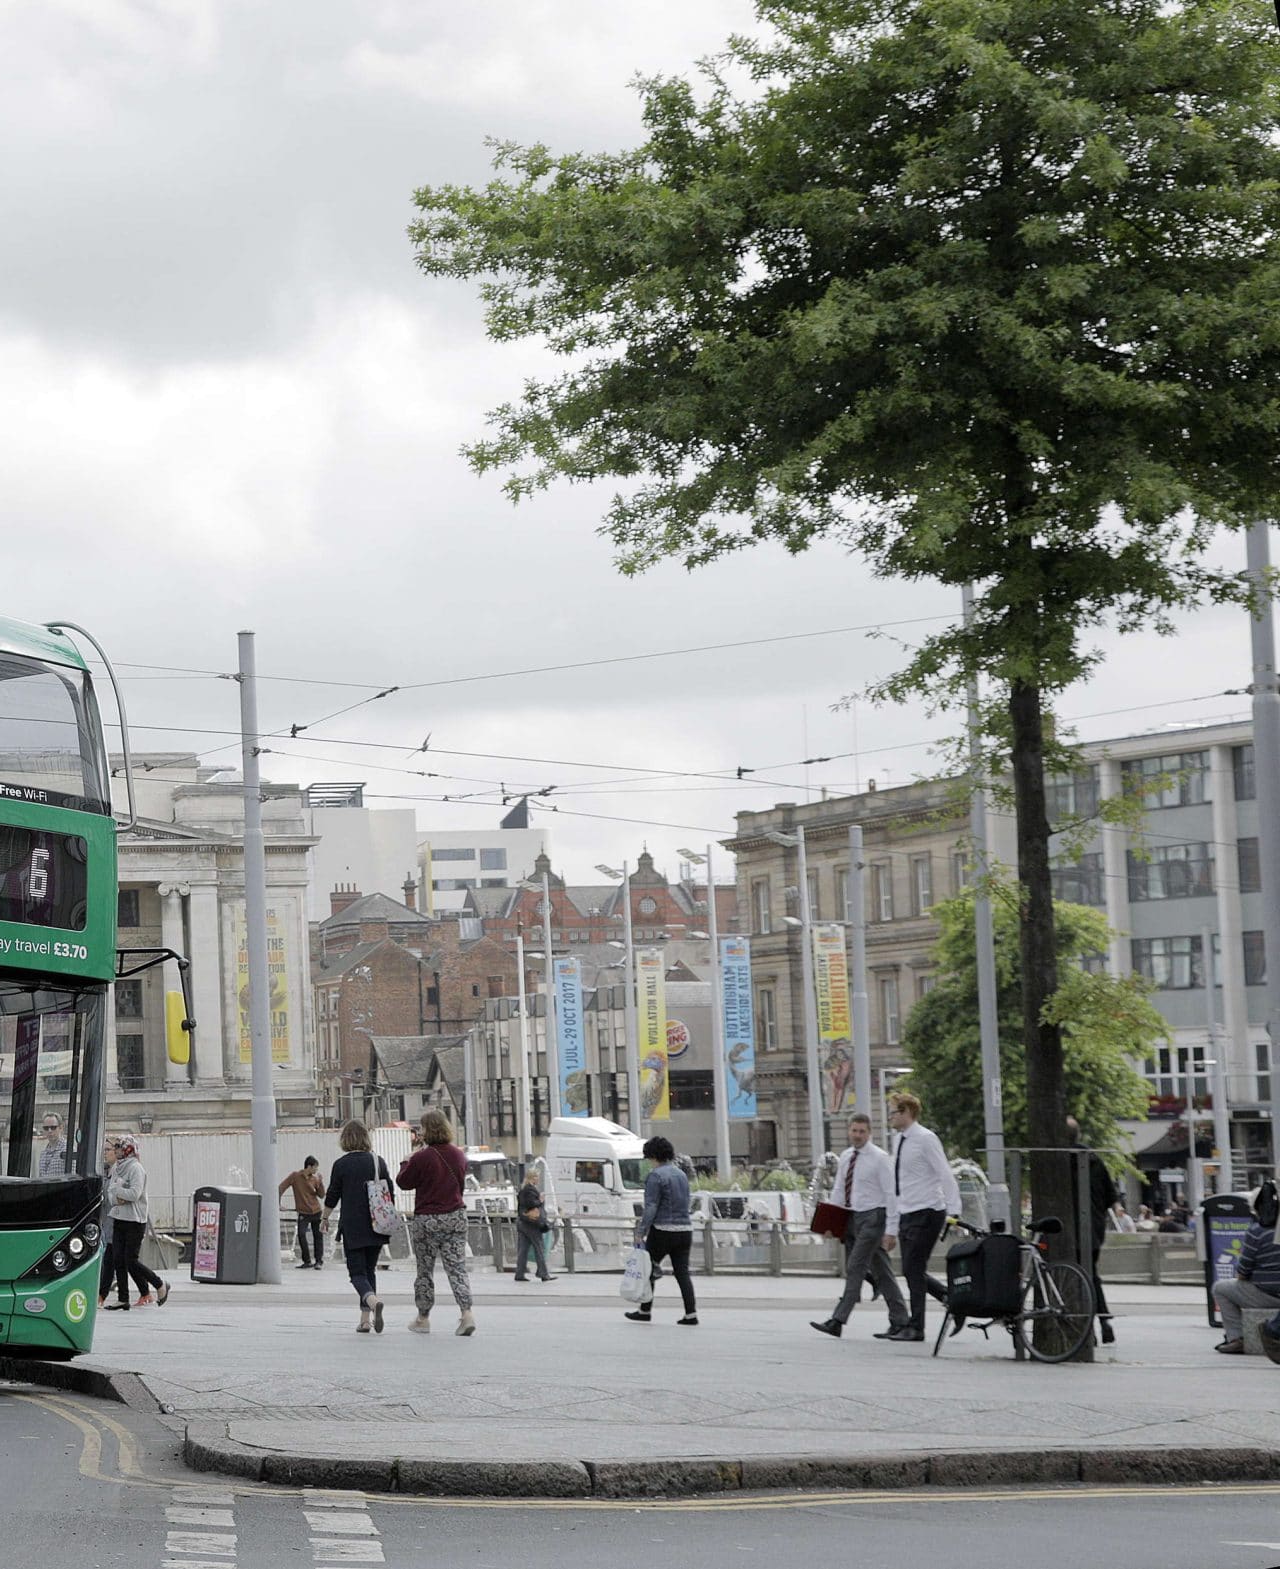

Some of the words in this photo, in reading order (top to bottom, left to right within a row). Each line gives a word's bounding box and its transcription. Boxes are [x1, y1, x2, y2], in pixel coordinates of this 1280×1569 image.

[0, 784, 22, 798] Free
[24, 788, 48, 802] Wi-Fi
[29, 848, 49, 898] 6
[15, 940, 50, 955] travel
[53, 942, 87, 959] £3.70
[646, 975, 657, 997] HALL
[737, 965, 748, 991] ARTS
[562, 981, 576, 1004] 2017
[724, 966, 739, 1039] NOTTINGHAM
[828, 953, 848, 1032] EXHIBITION
[563, 1007, 577, 1026] OCT
[648, 998, 658, 1046] WOLLATON
[738, 994, 751, 1039] LAKESIDE
[200, 1210, 216, 1227] BIG
